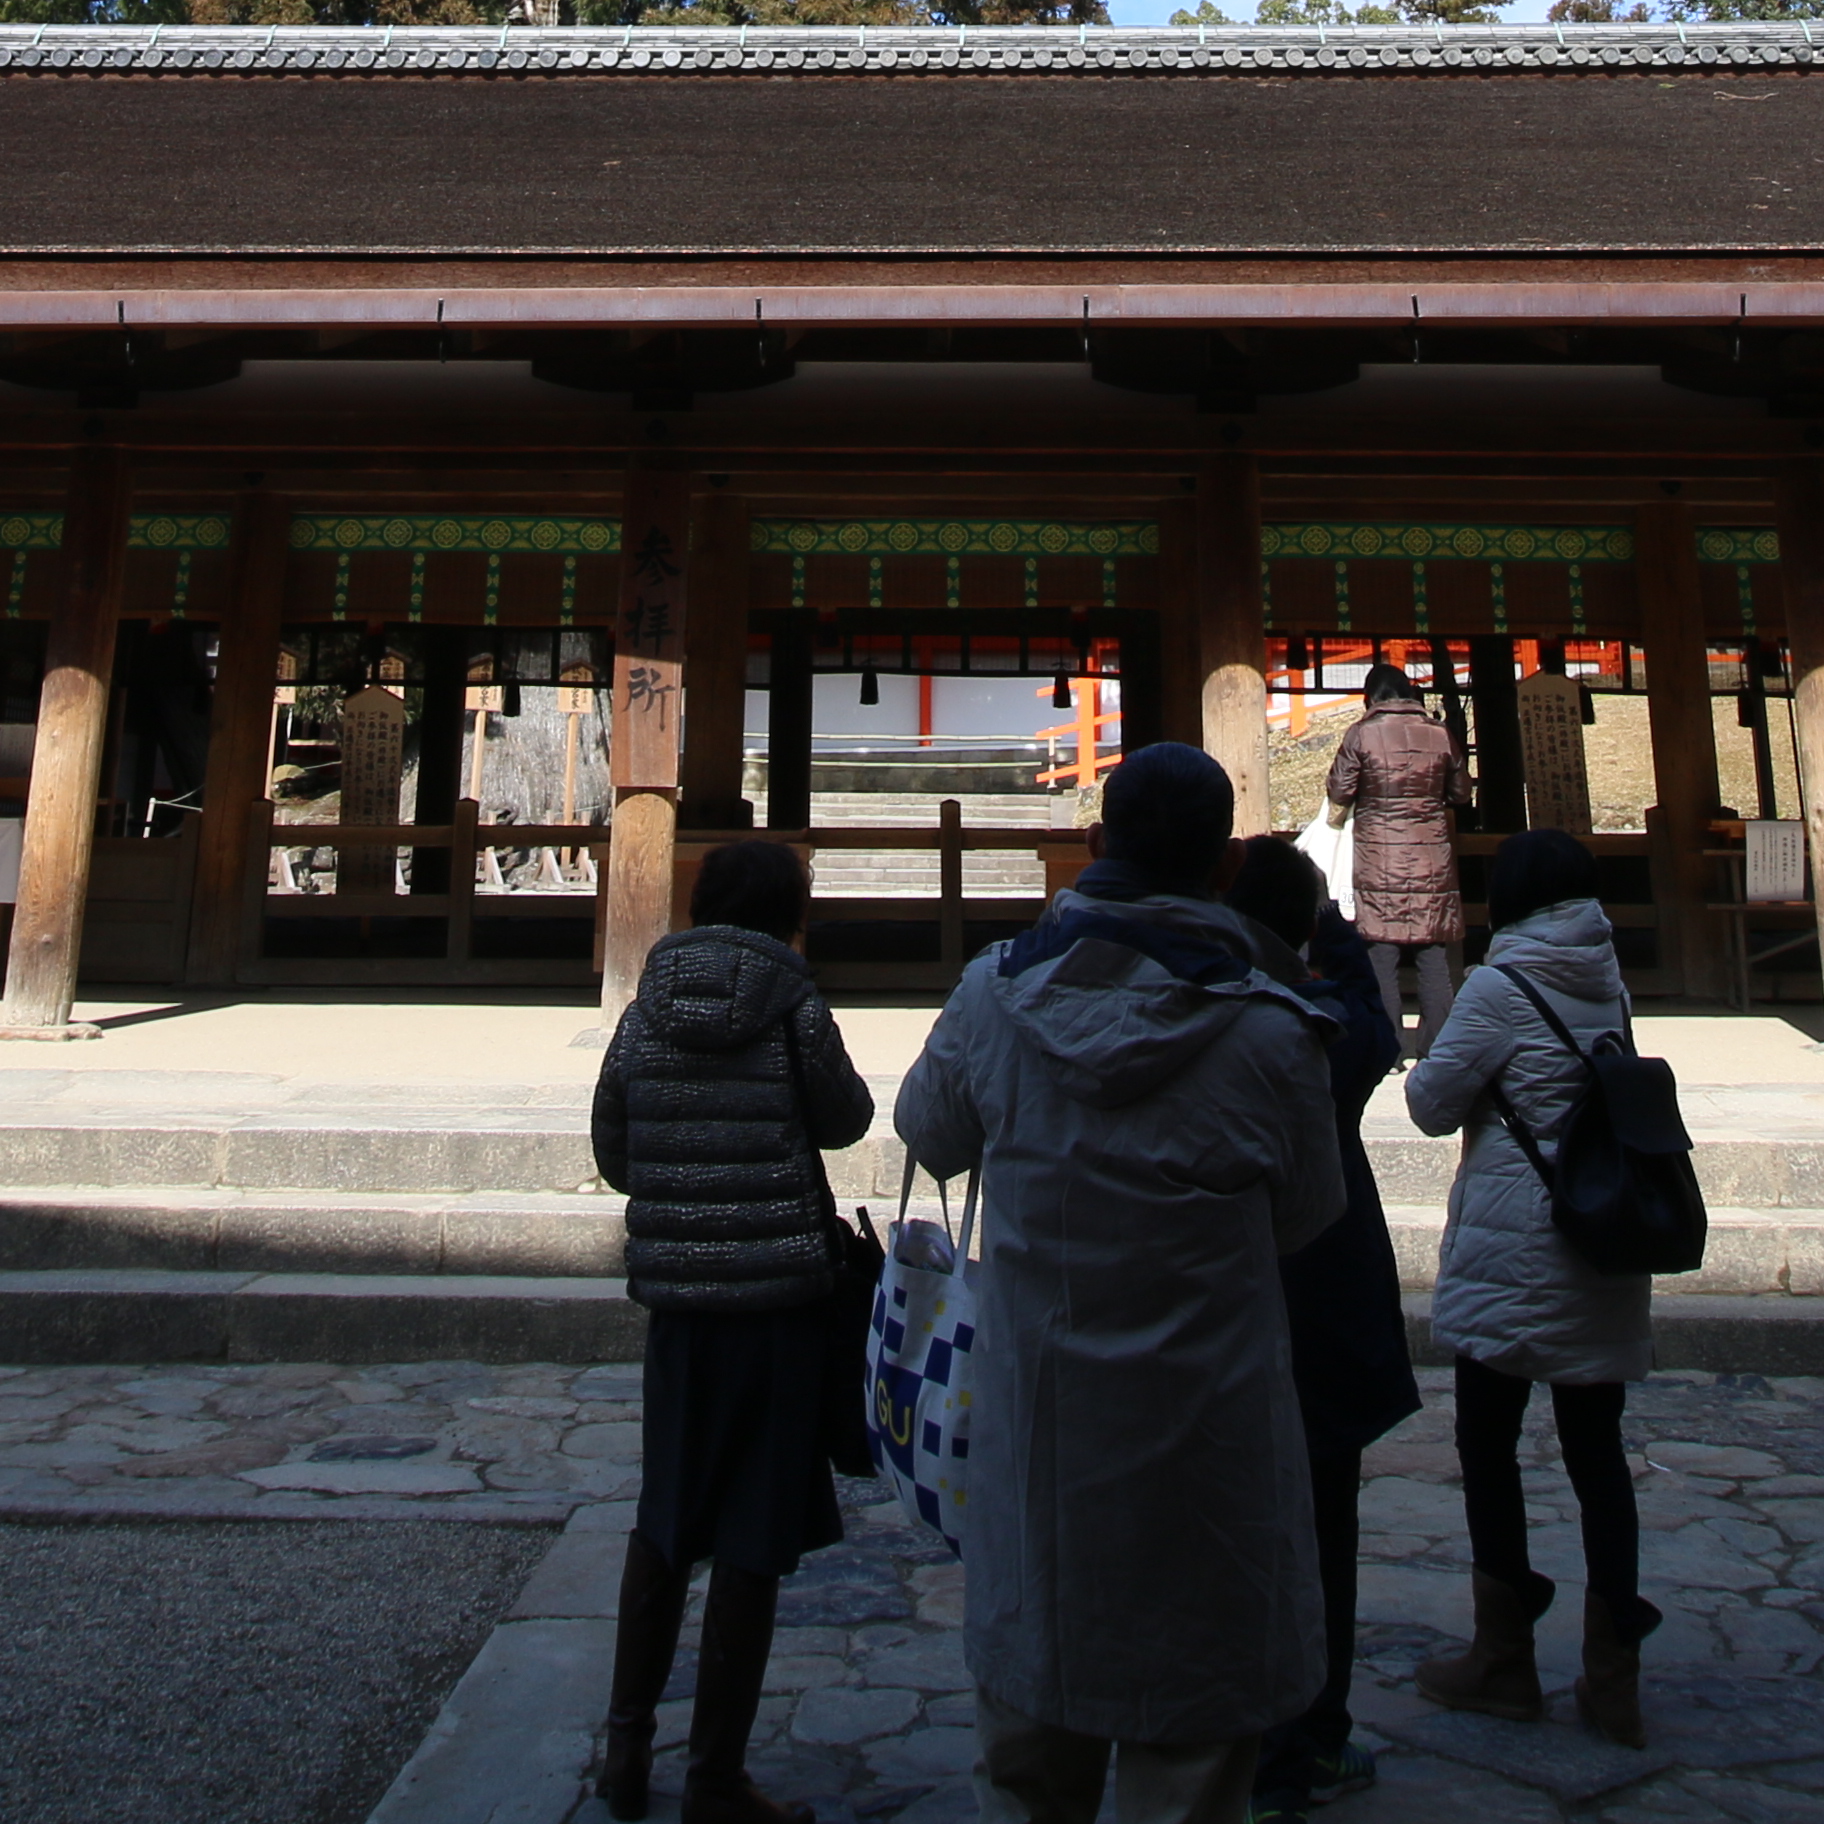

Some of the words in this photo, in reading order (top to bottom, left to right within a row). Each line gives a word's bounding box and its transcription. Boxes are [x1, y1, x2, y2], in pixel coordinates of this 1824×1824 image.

[623, 528, 682, 732] 参拝所
[877, 1378, 911, 1445] GU
